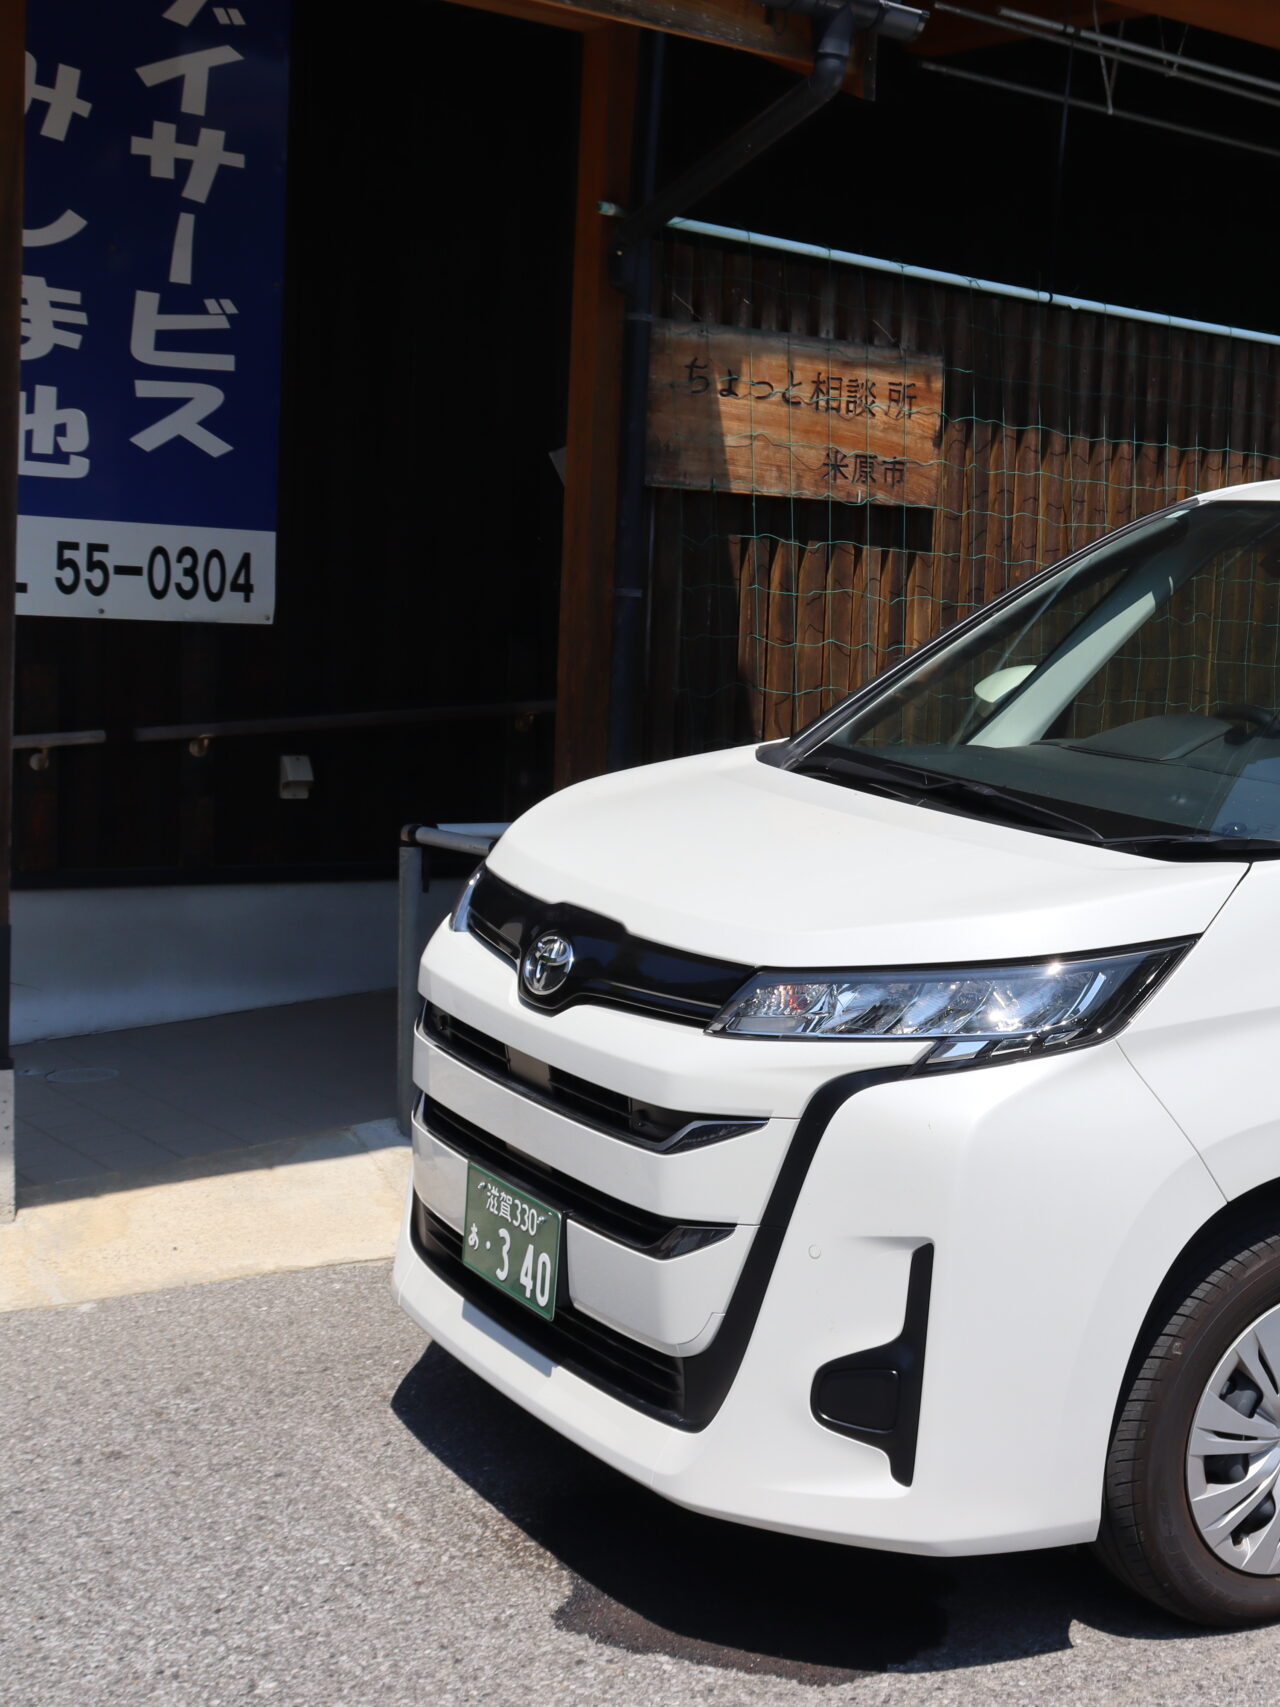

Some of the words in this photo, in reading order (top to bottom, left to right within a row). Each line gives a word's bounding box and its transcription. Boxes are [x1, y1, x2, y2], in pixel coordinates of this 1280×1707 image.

[684, 356, 917, 421] ちょっと相談所
[823, 452, 906, 489] 米原市
[55, 540, 254, 603] 55-0304
